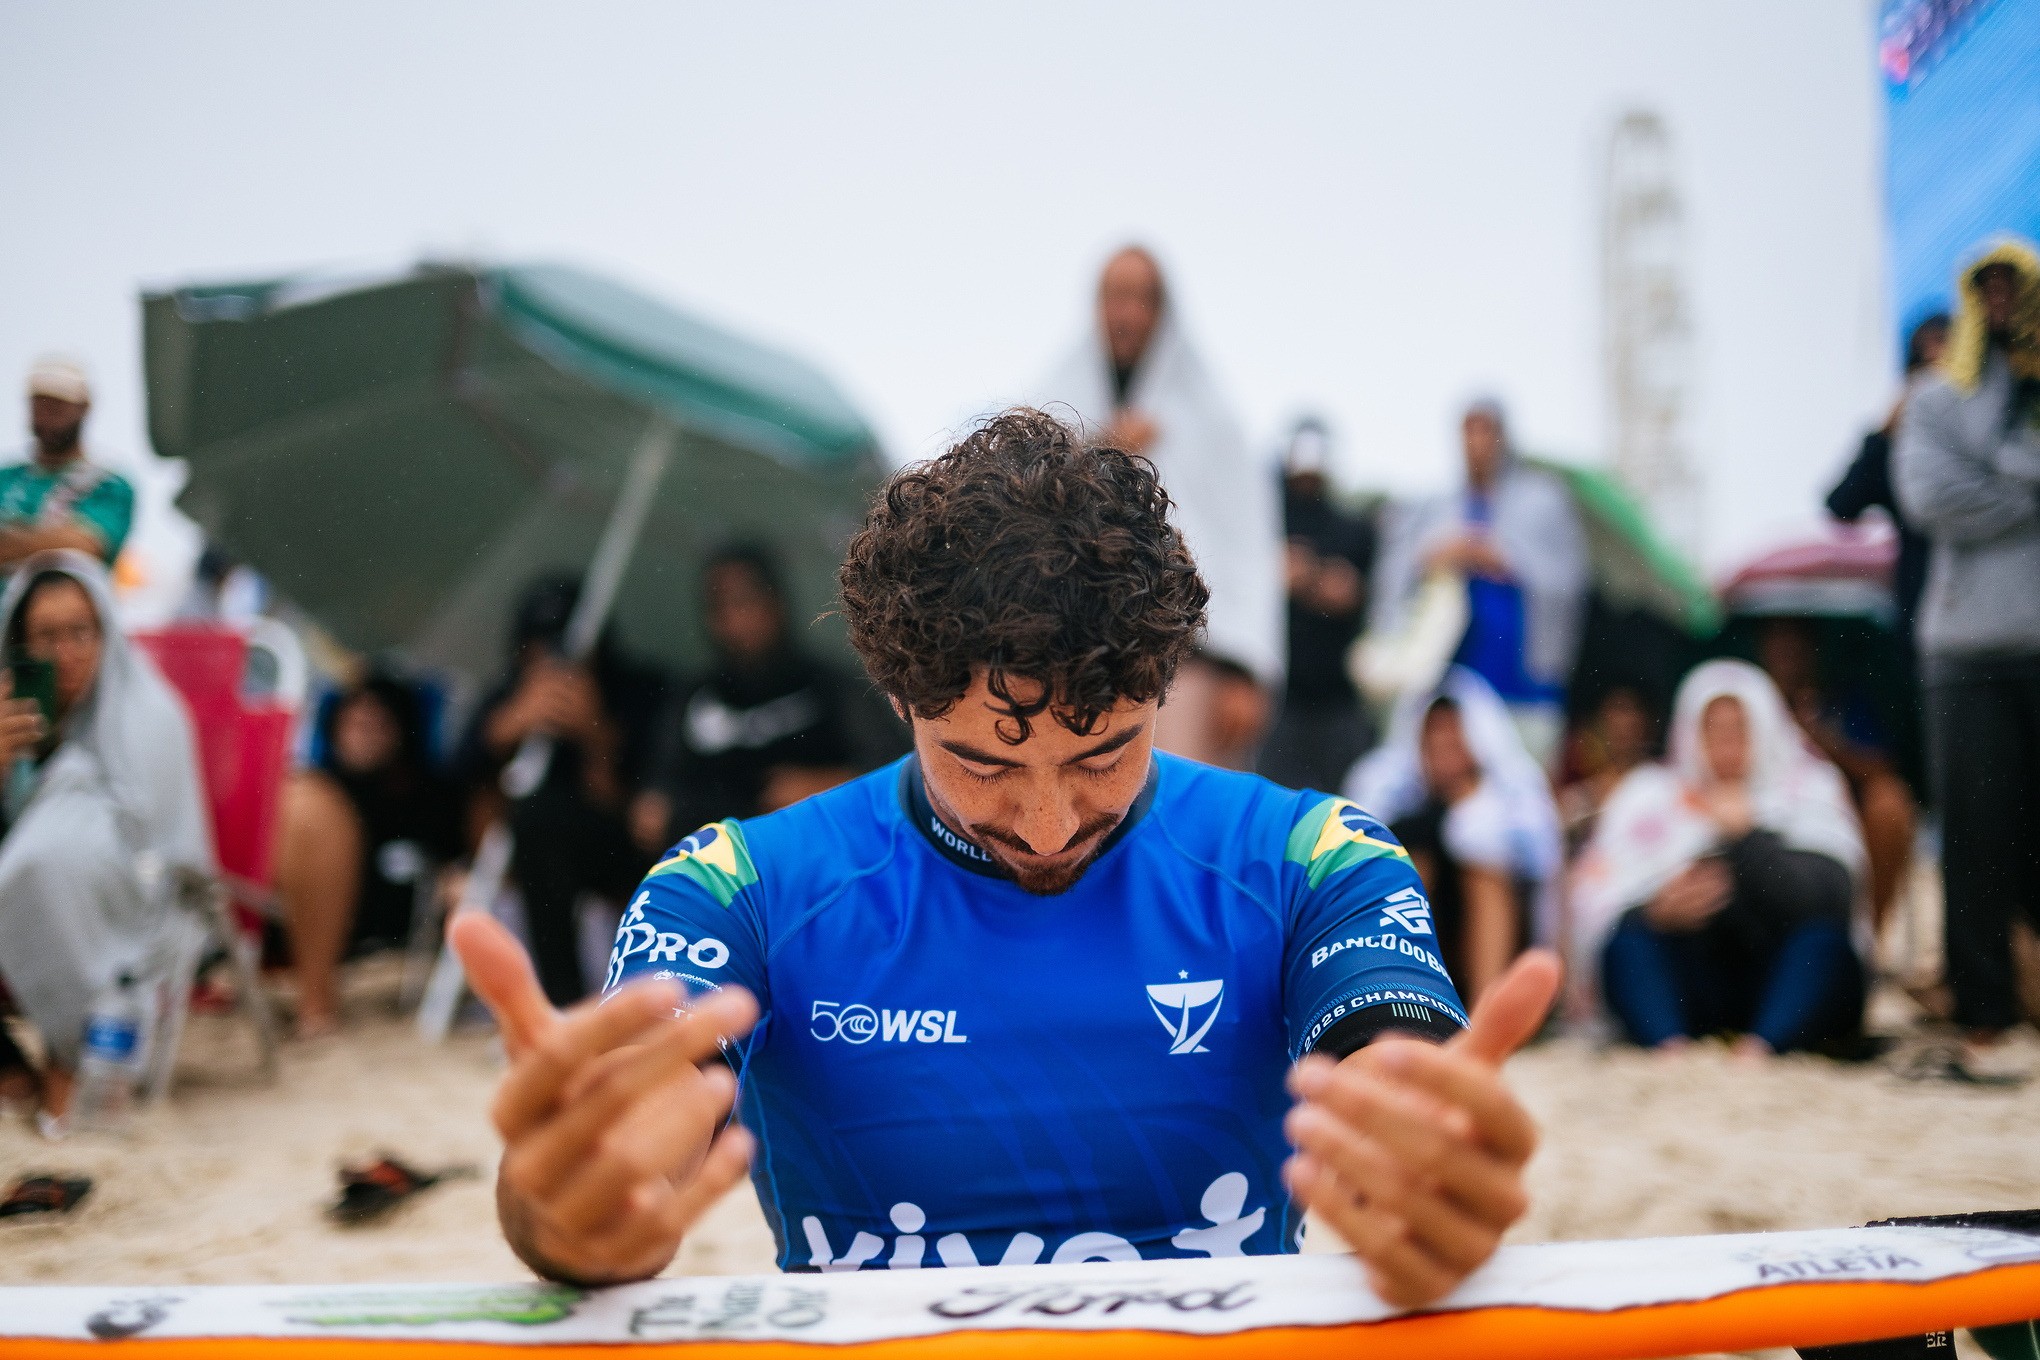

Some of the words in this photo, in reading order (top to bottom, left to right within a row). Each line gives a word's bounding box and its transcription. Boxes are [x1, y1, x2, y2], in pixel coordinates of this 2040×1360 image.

[613, 922, 730, 978] PRO
[1312, 933, 1397, 969] BANCO
[1400, 938, 1427, 964] DO
[881, 1009, 967, 1044] WSL
[1304, 1005, 1347, 1052] 2026
[1757, 1253, 1922, 1279] ATLETA
[927, 1279, 1256, 1319] Ford
